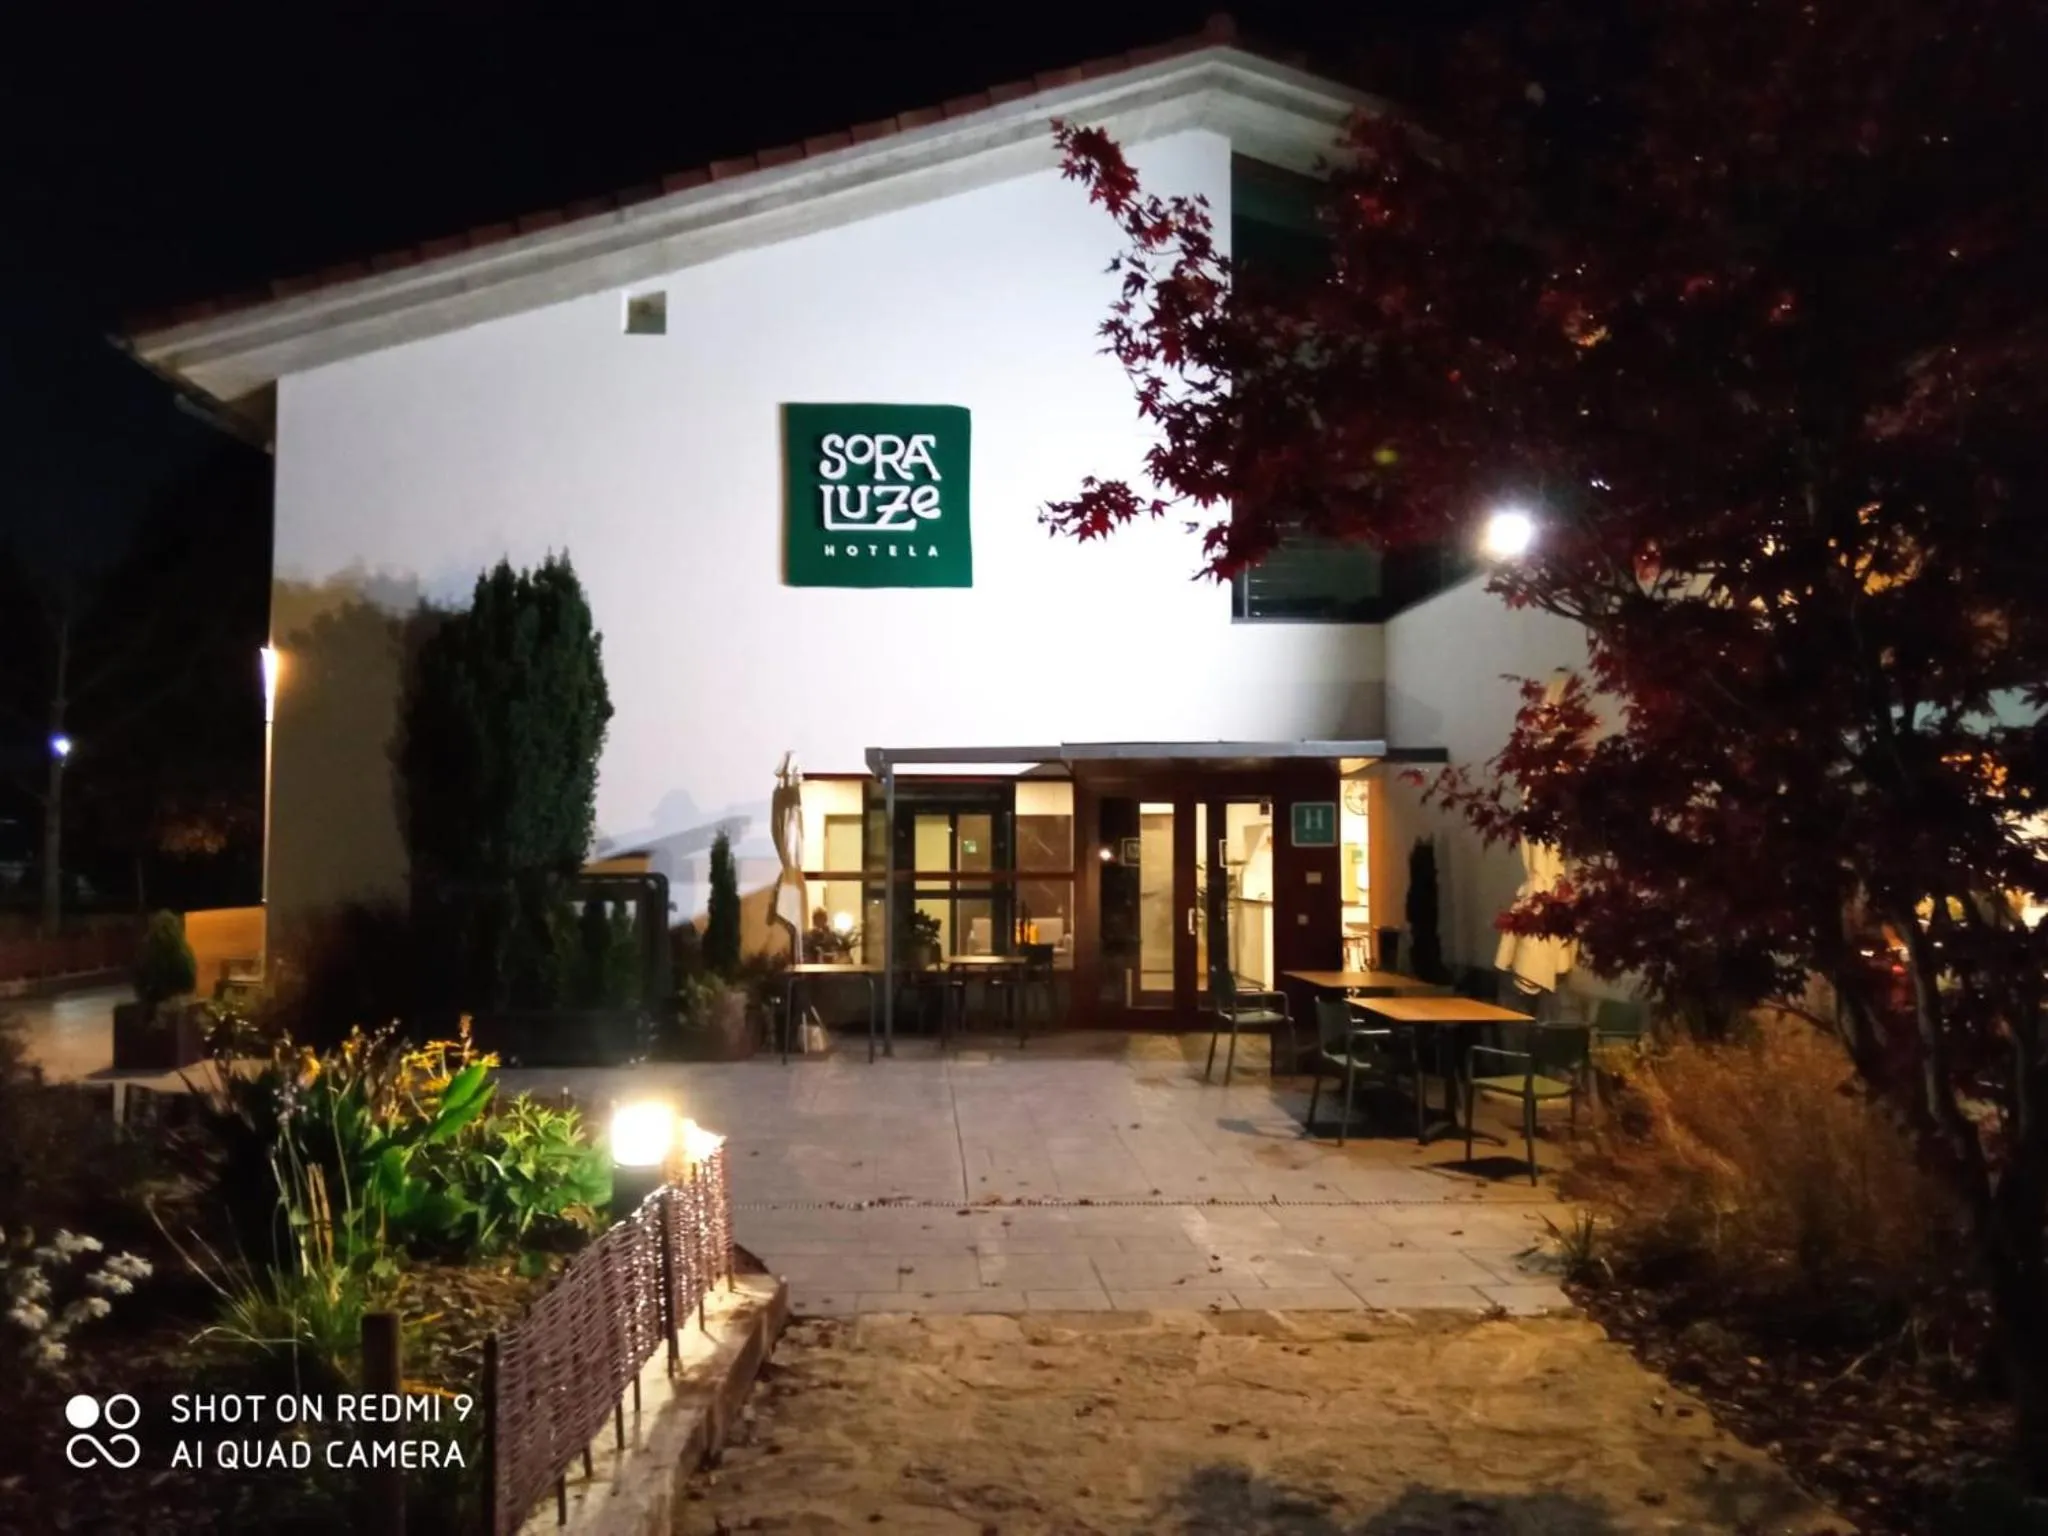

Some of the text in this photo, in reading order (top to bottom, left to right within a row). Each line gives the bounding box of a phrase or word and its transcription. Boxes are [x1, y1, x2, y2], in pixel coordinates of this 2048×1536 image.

[819, 433, 942, 480] SORA
[824, 545, 938, 556] HOTELA
[1304, 808, 1323, 830] H
